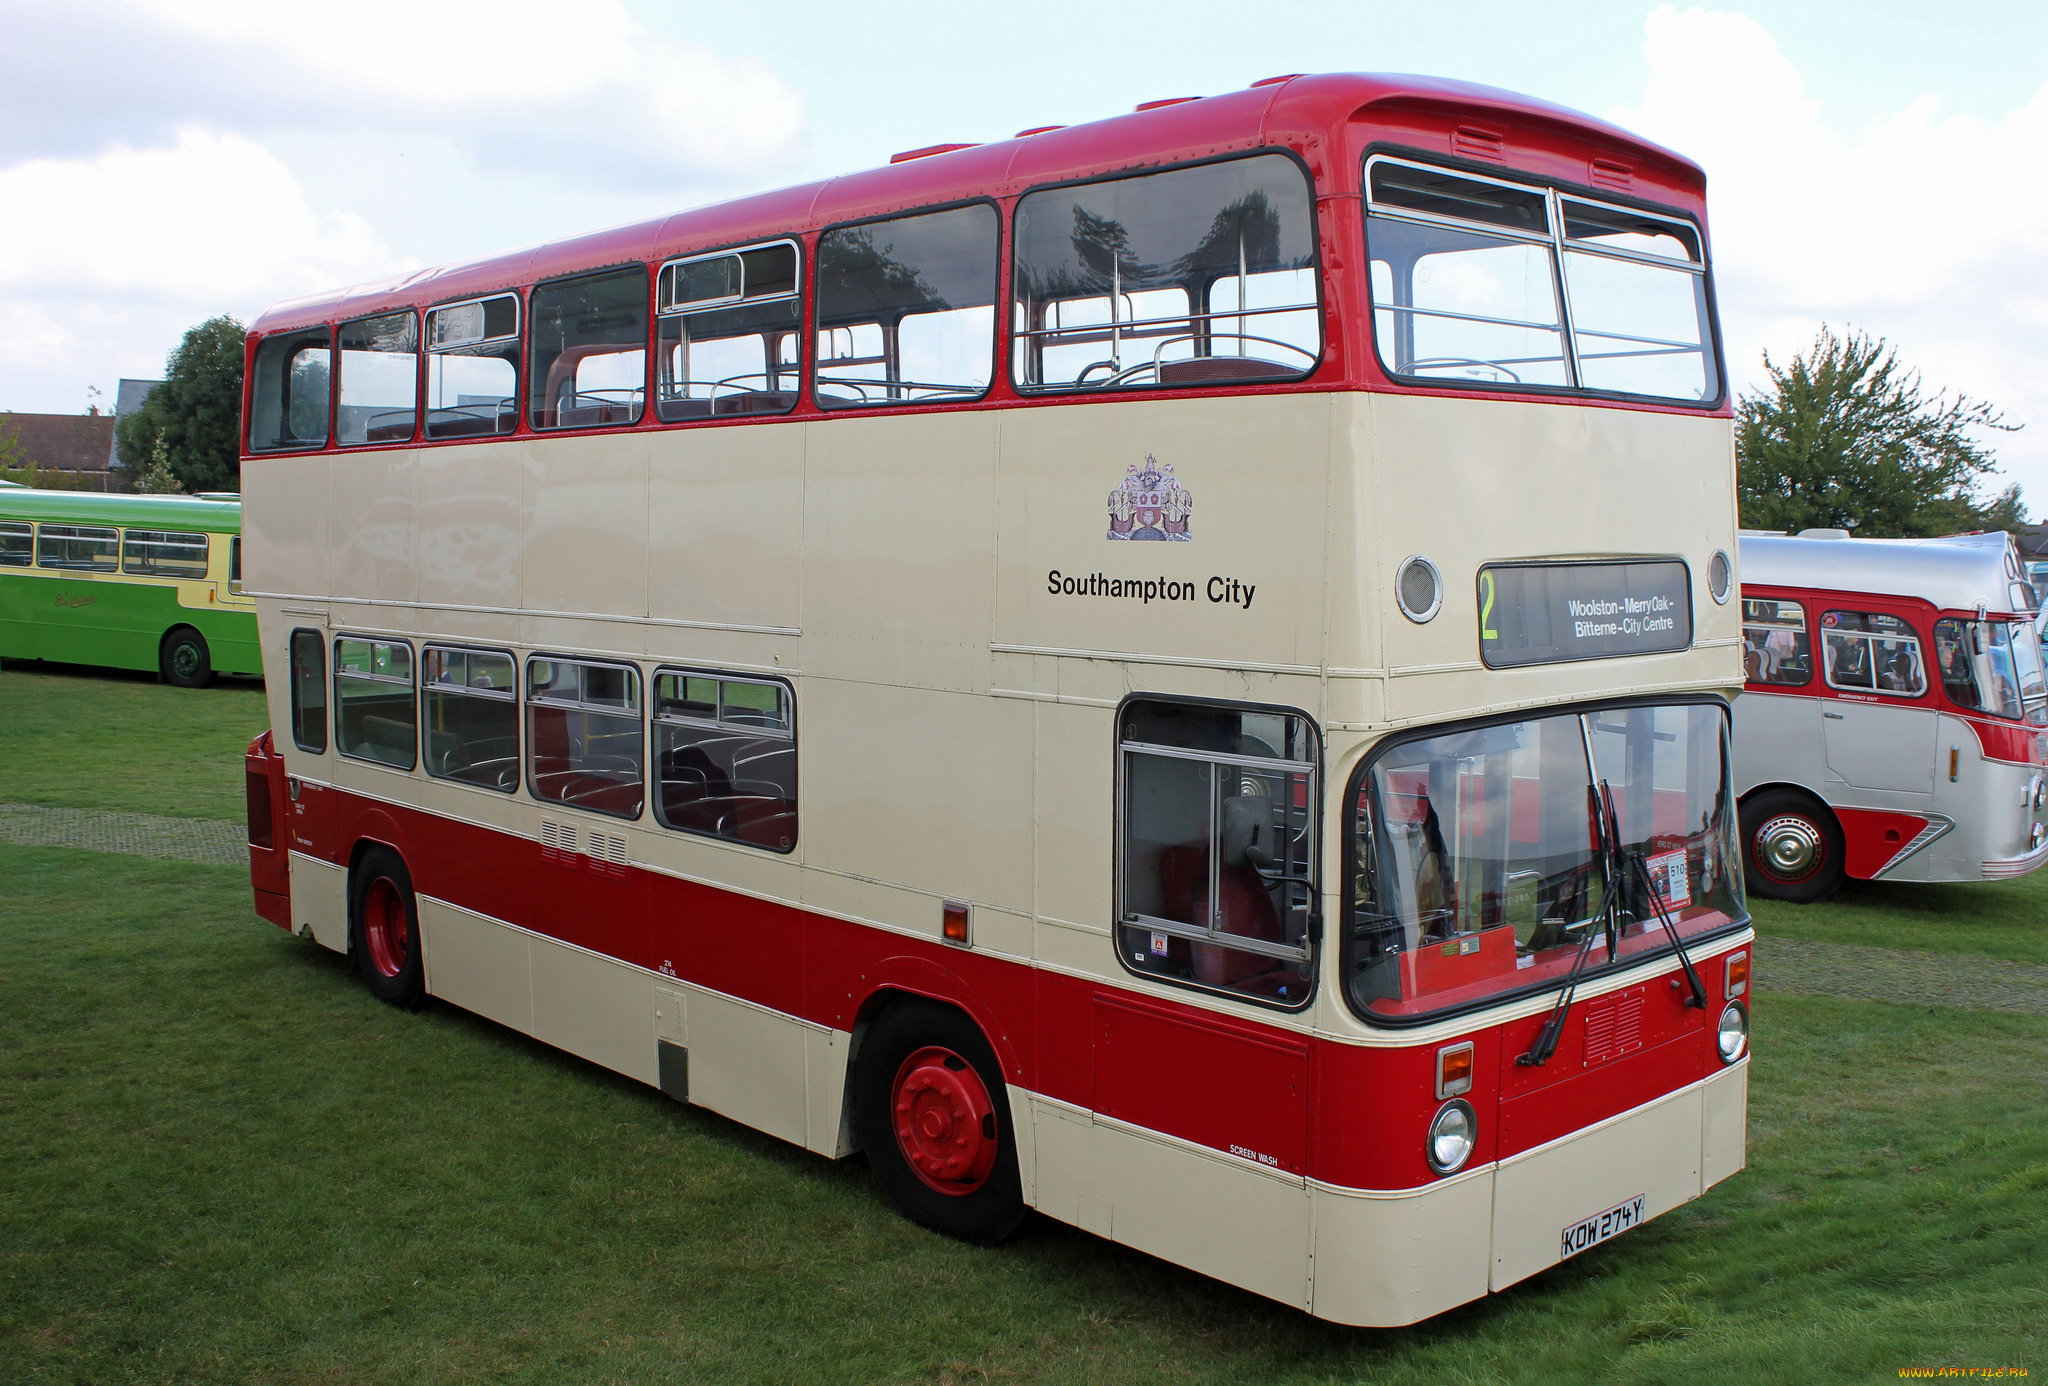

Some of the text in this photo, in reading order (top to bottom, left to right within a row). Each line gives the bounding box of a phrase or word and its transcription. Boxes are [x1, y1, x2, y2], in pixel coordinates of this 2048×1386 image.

[1047, 569, 1256, 609] Southampton City
[1479, 569, 1498, 640] 2
[1643, 615, 1674, 632] Centre
[1670, 863, 1685, 877] 510
[1229, 1144, 1278, 1167] SCREEN WASH
[1564, 1198, 1642, 1255] KOW 274Y
